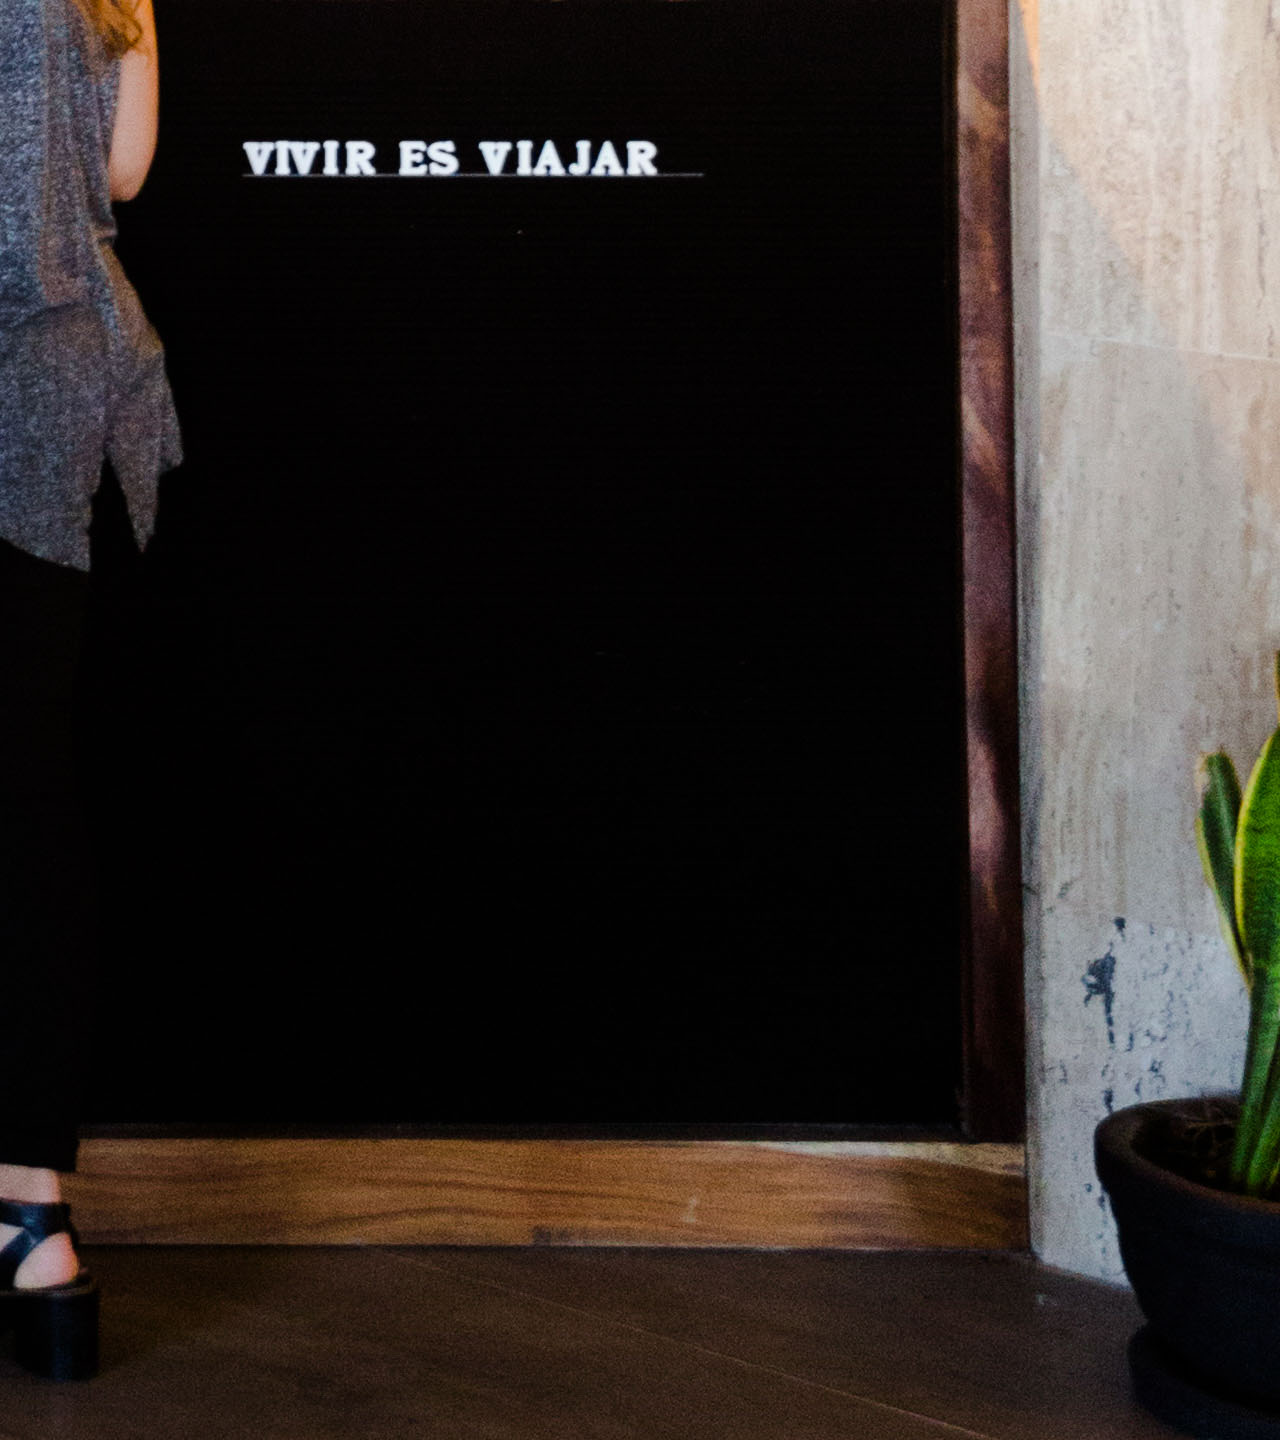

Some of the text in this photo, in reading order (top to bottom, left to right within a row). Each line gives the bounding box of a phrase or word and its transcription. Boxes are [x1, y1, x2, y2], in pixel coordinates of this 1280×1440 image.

[242, 140, 658, 175] VIVIR ES VIAJAR
